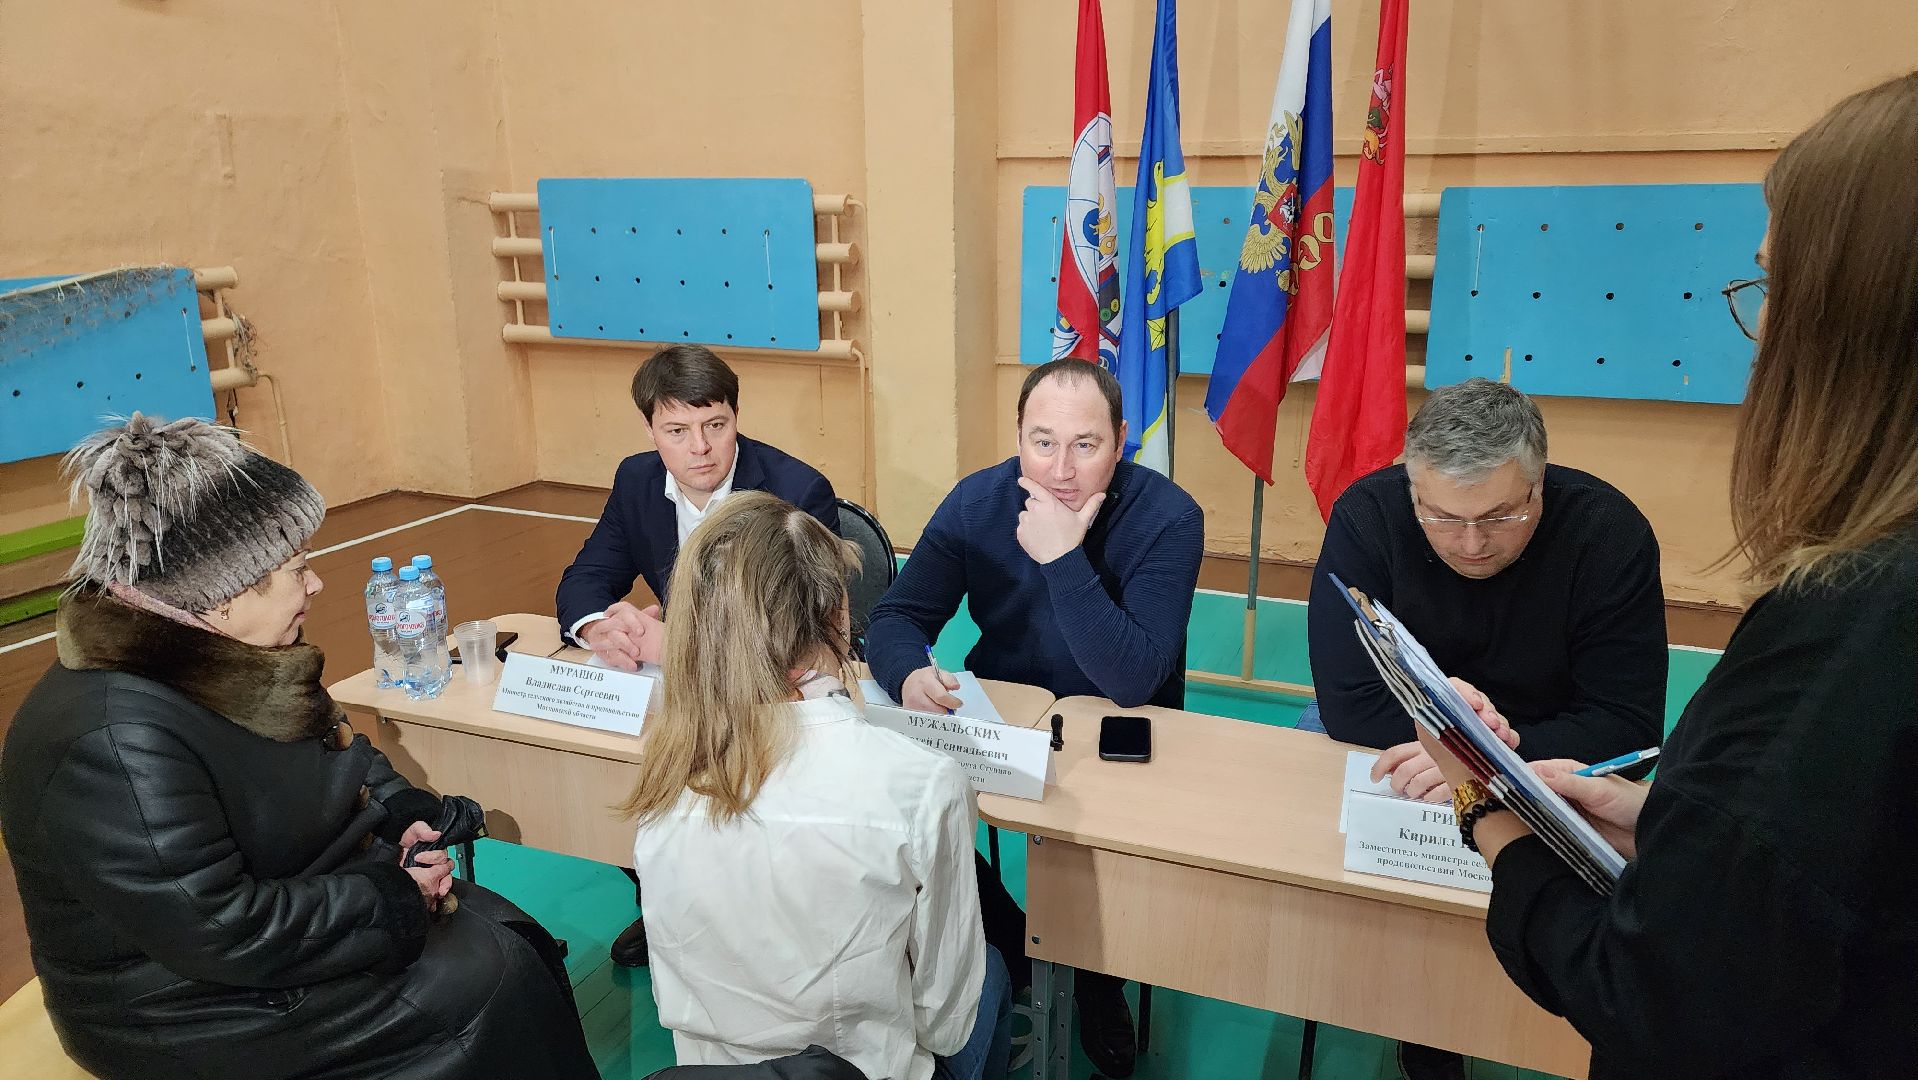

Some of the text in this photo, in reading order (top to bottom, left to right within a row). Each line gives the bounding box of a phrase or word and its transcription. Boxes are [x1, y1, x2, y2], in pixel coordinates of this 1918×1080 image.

[550, 664, 605, 682] МУРАШОВ
[525, 676, 621, 702] Владислав Сергеевич
[907, 715, 1002, 741] МУЖАЛЬСКИХ
[936, 738, 1009, 761] Геннадьевич
[1399, 827, 1456, 848] Кирилл
[1359, 841, 1419, 858] Заместитель
[1421, 853, 1469, 867] министра
[1377, 857, 1492, 882] продовольствия Моско
